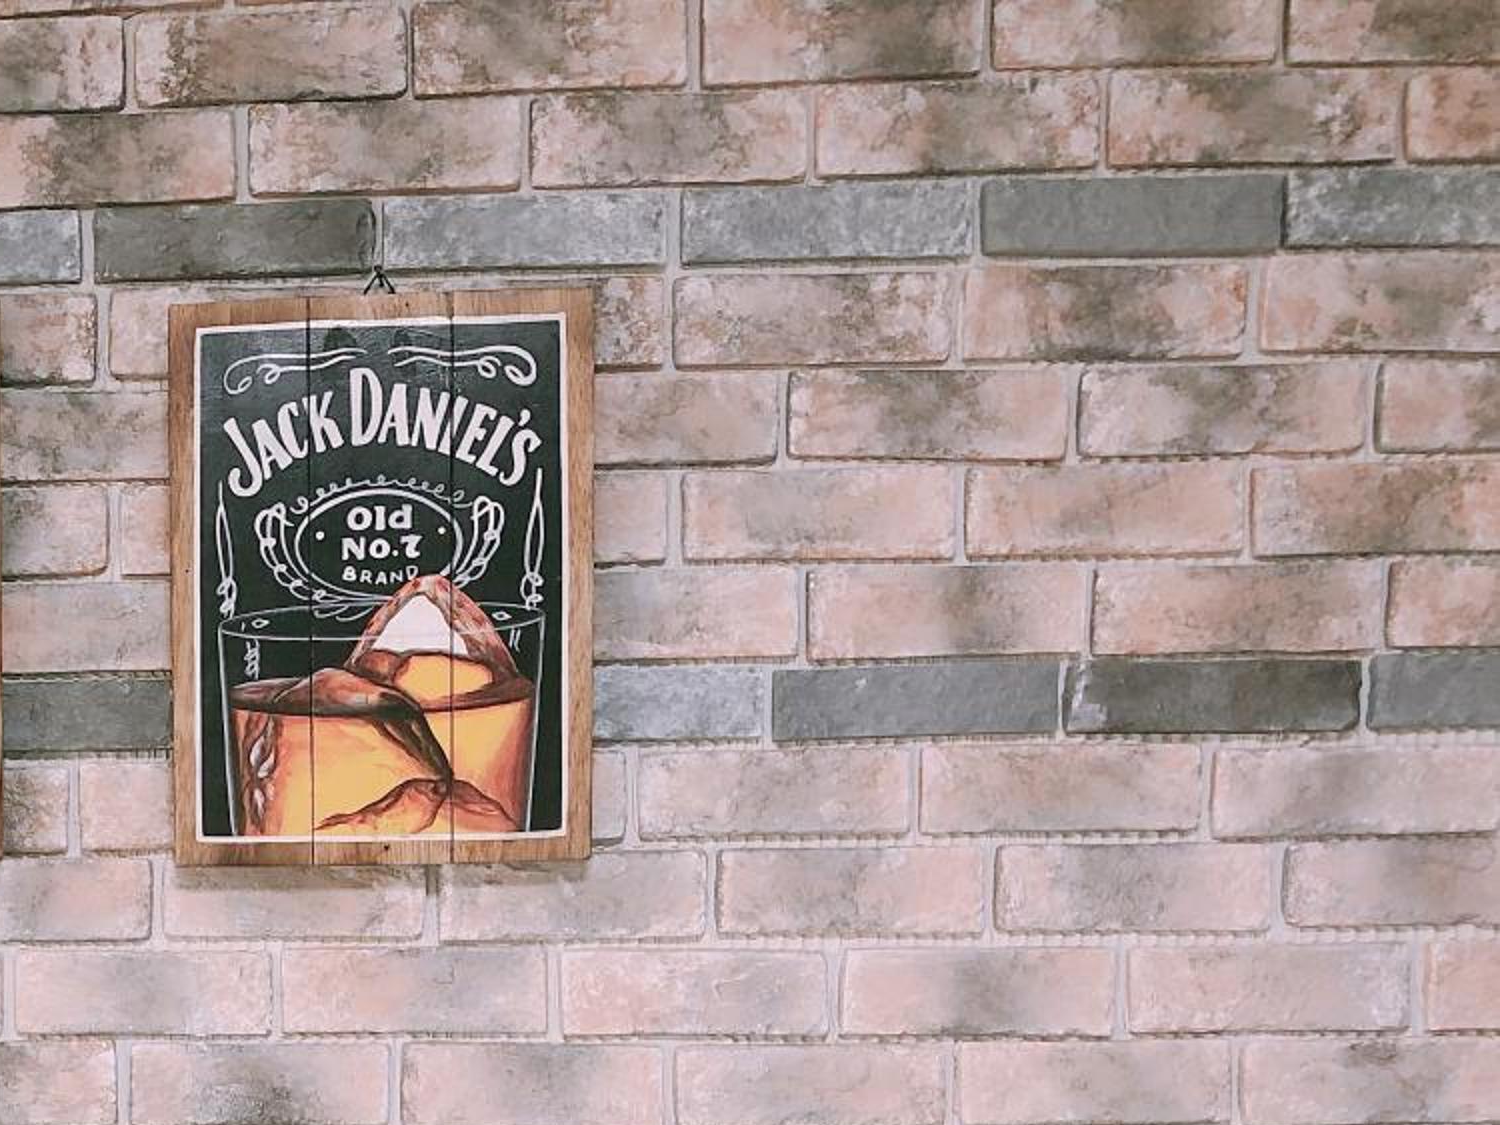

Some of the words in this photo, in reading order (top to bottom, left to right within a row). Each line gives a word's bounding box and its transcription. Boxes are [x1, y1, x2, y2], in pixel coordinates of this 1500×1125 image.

[222, 390, 344, 498] JACK
[348, 366, 542, 487] DANIEL'S
[346, 503, 413, 531] Old
[340, 565, 420, 585] BRAND
